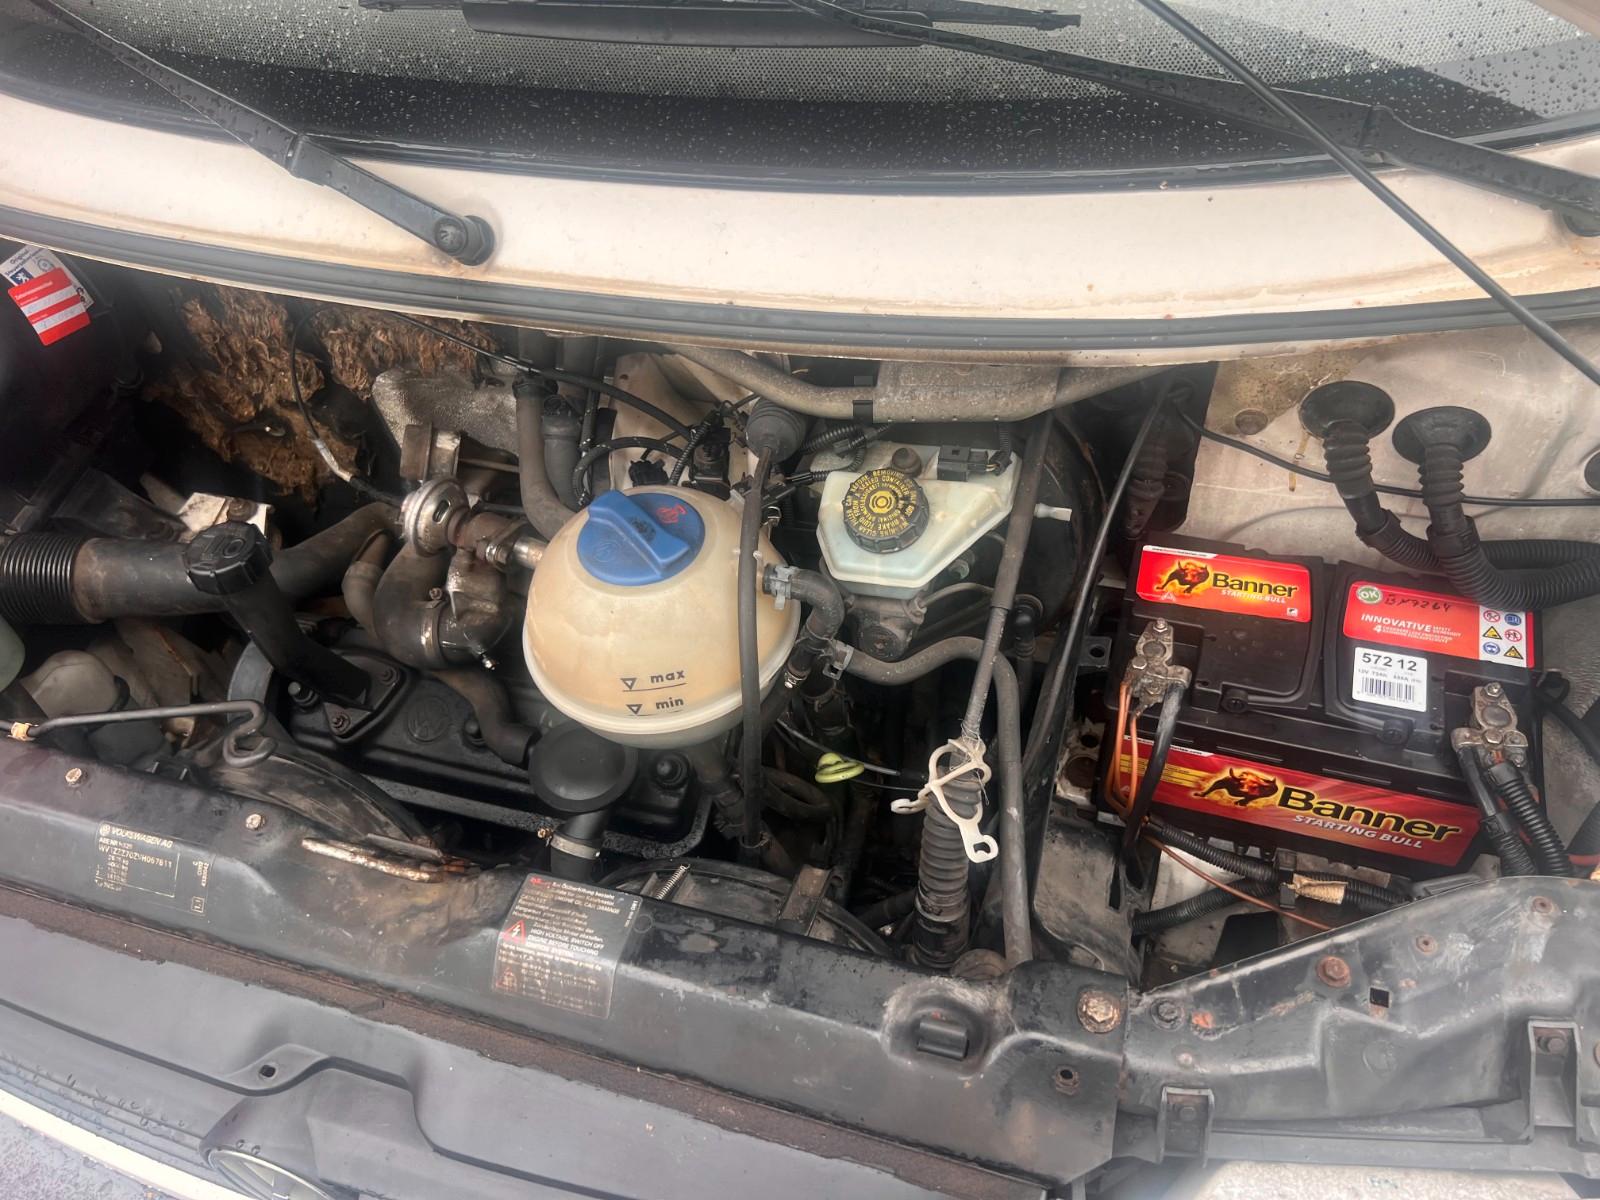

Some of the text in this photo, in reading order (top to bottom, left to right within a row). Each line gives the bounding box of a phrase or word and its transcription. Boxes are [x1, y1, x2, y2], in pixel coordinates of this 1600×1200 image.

[881, 475, 910, 496] CONTAINER
[1212, 572, 1298, 598] Banner
[1360, 590, 1378, 600] OK
[1220, 589, 1287, 604] STARTING BULL
[1361, 613, 1432, 633] INNOVATIVE
[1373, 624, 1382, 633] 4
[650, 670, 685, 683] max
[655, 697, 684, 710] min
[1278, 786, 1461, 841] Banner
[111, 827, 161, 845] VOLKSWAGEN
[160, 840, 174, 849] AG
[1293, 815, 1423, 849] STARTING BULL
